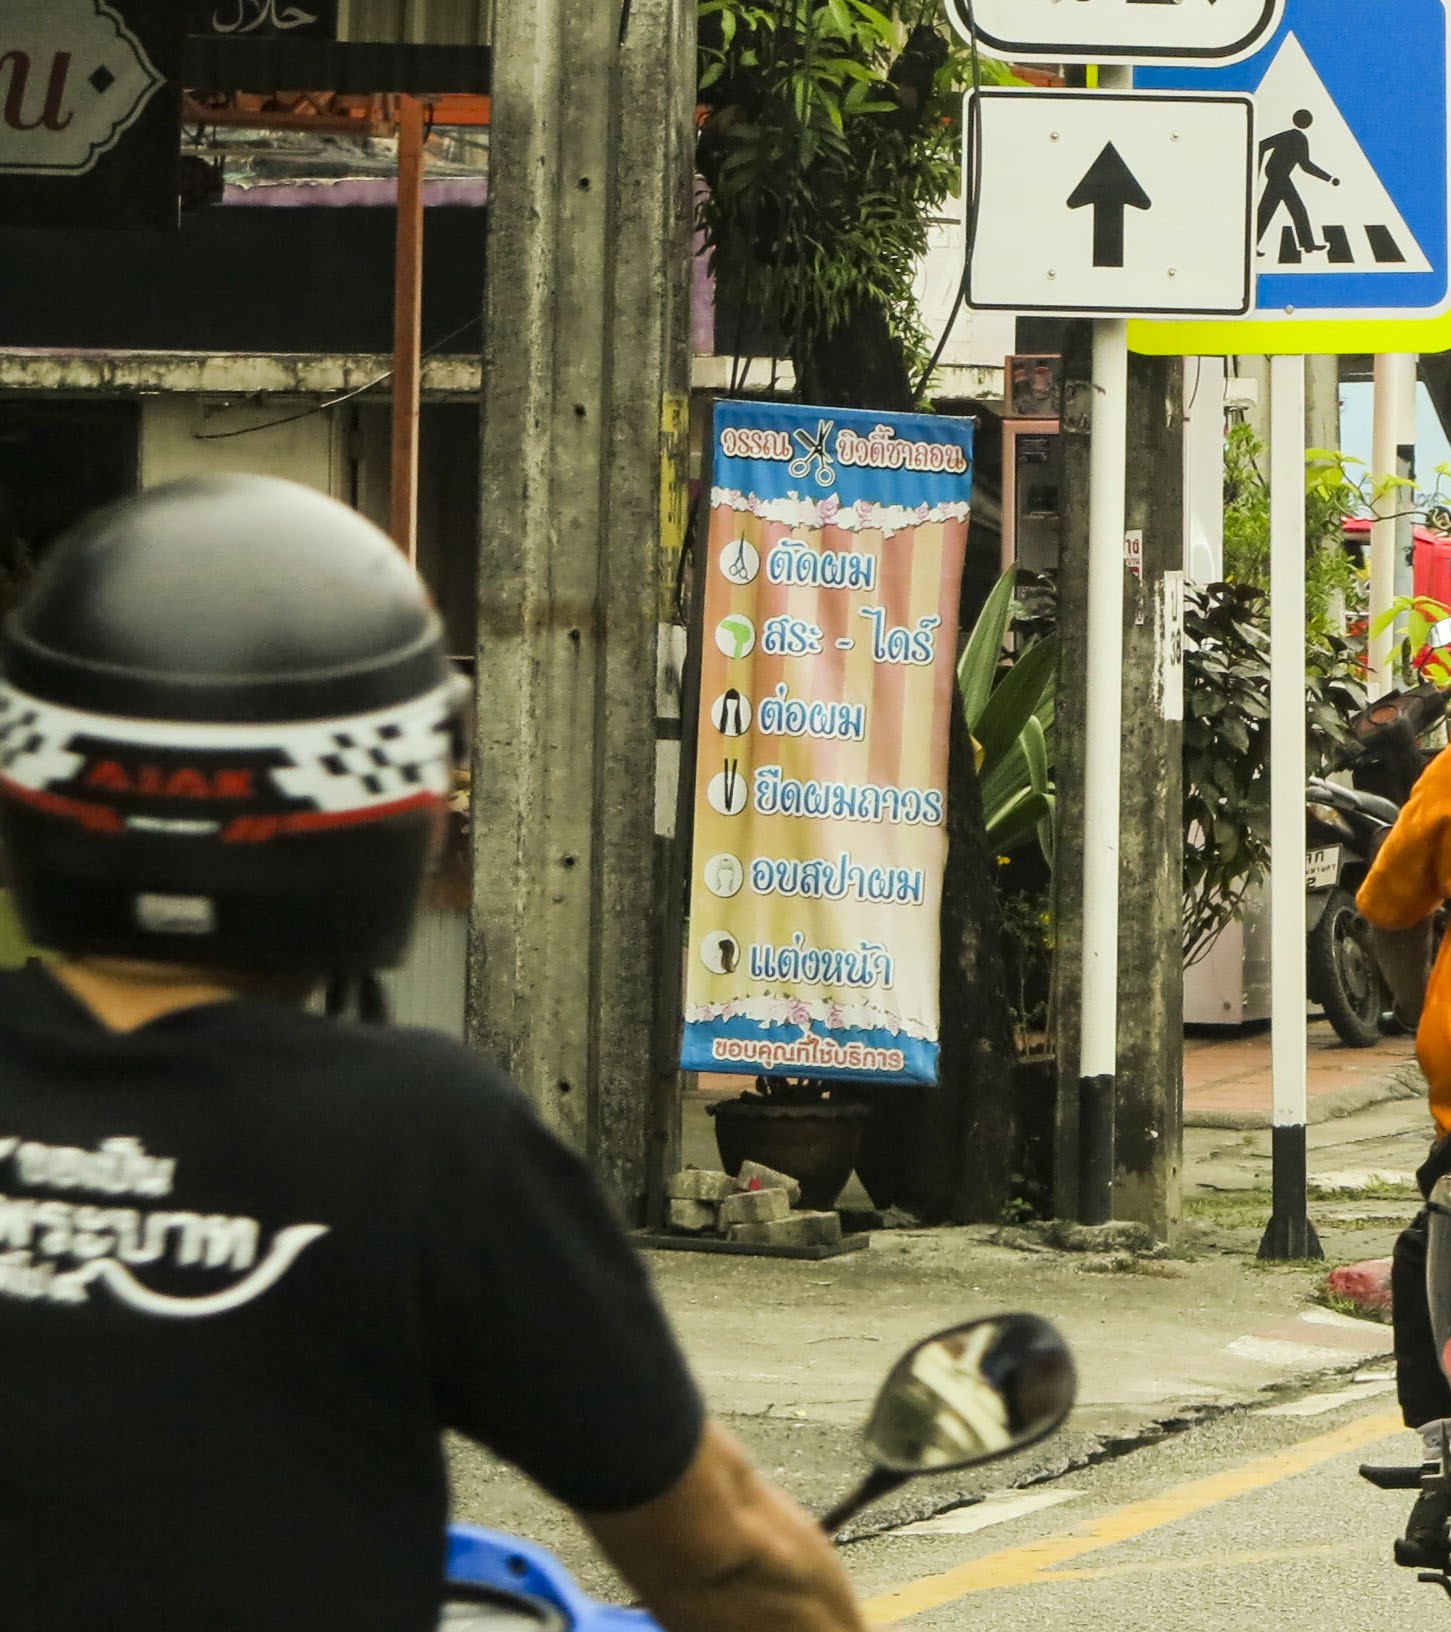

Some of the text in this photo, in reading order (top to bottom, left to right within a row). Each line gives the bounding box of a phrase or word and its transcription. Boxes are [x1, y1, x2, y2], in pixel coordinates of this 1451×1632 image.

[767, 539, 877, 591] ตัดผม
[763, 616, 824, 656] สระ
[859, 607, 941, 666] ไดร์
[759, 684, 866, 741] ต่อผม
[754, 764, 944, 826] ยืดผมถาวร
[750, 852, 925, 905] อบสปาผม
[749, 930, 895, 989] แต่งหน้า
[713, 1034, 905, 1072] ขอบคุณที่ใช้บริการ
